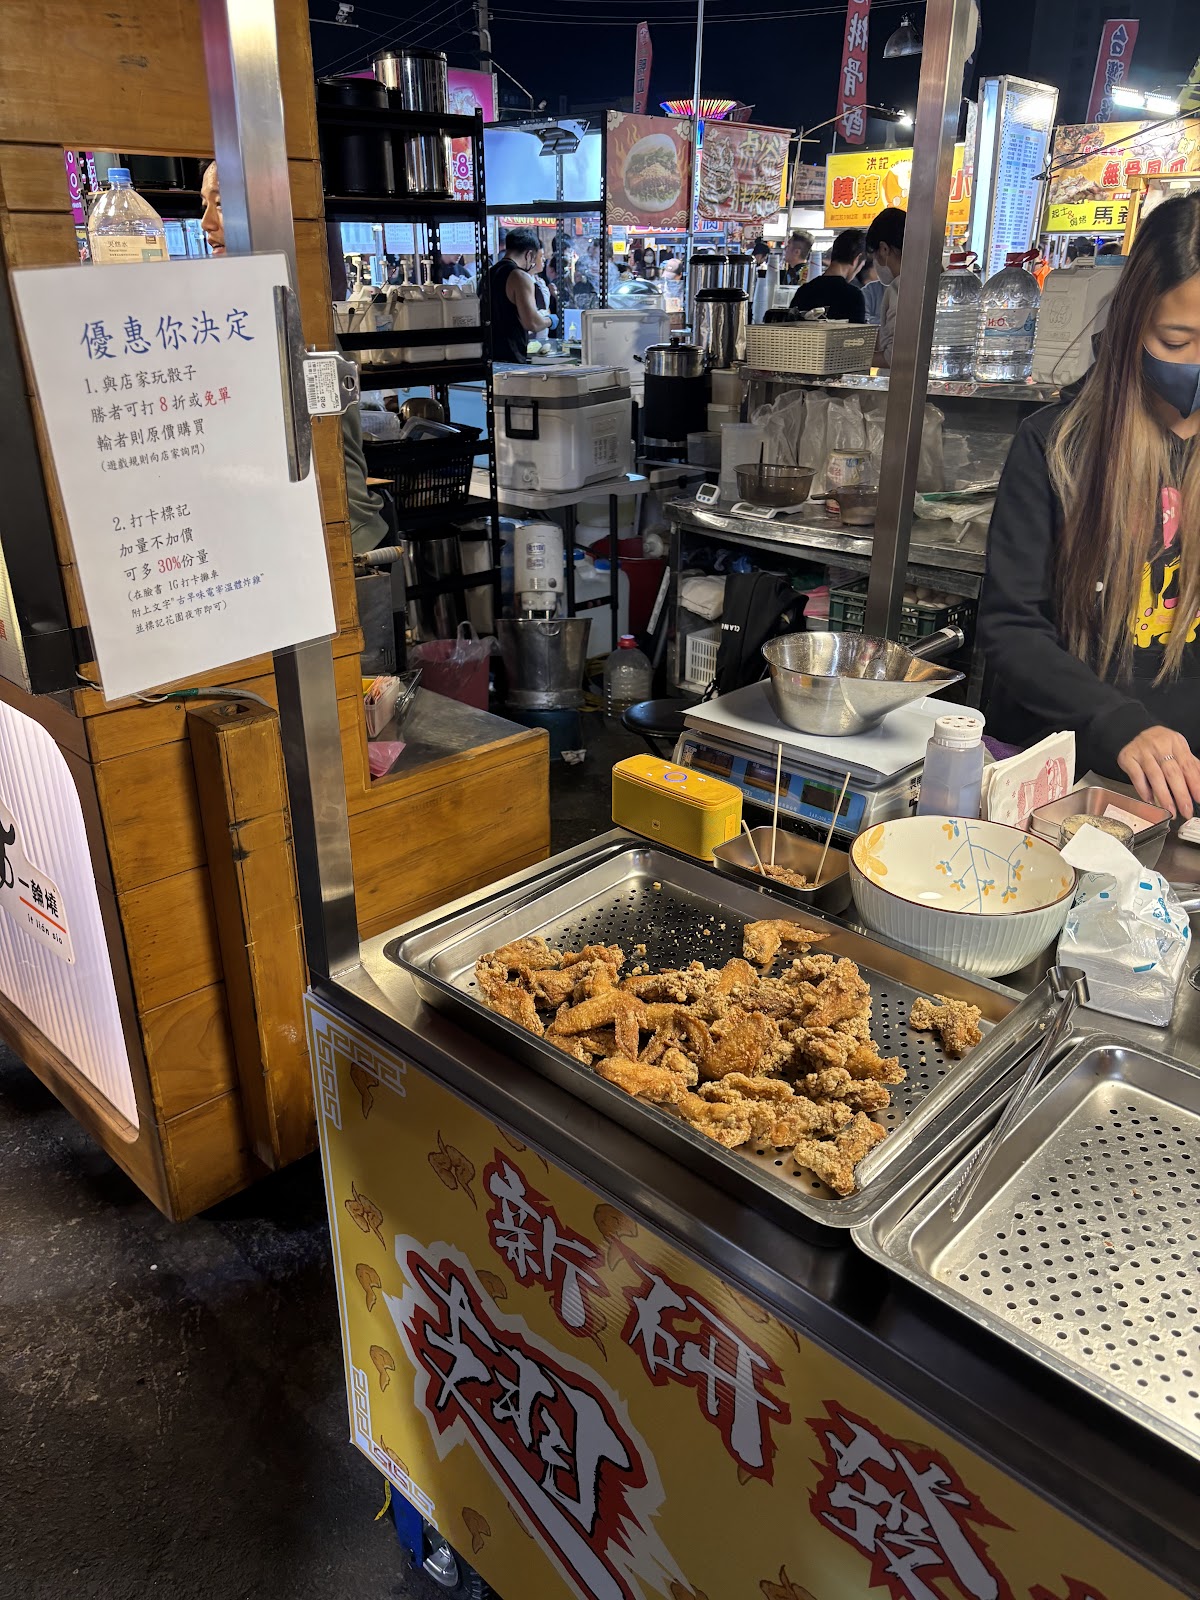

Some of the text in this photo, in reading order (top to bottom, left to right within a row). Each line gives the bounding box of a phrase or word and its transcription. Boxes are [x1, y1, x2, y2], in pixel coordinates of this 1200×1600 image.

[866, 157, 889, 170] 洪記
[80, 308, 255, 360] 優惠你決定
[96, 418, 205, 452] 輸者則原價購買
[119, 527, 194, 558] 加量不加價
